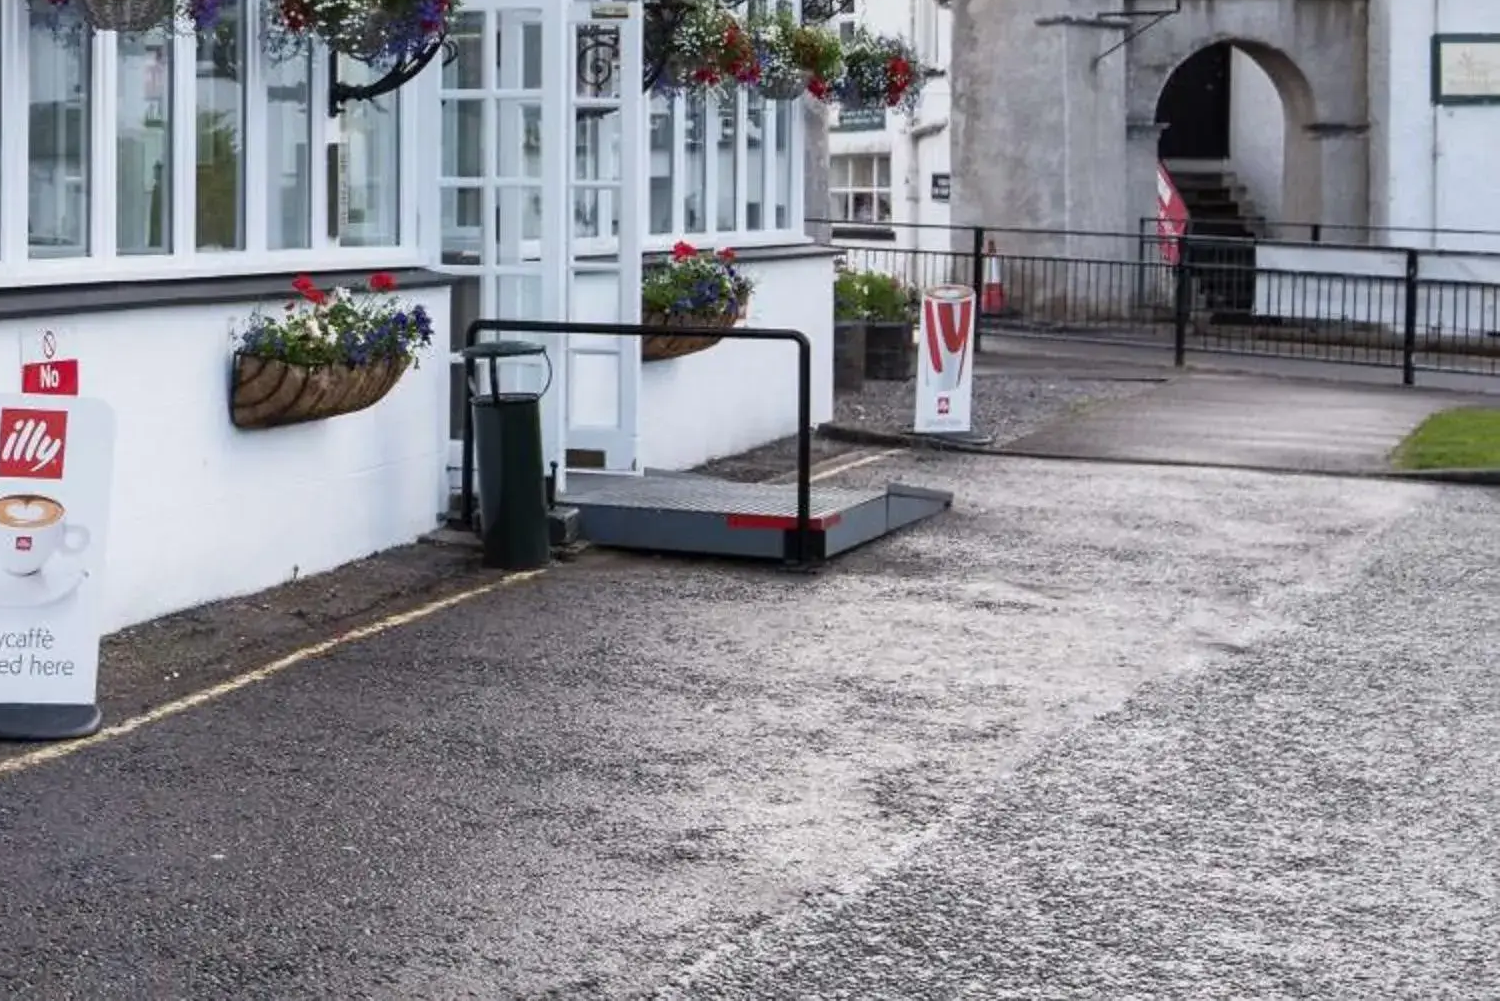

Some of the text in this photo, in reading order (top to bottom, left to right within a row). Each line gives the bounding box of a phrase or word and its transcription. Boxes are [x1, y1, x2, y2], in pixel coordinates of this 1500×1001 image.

[39, 365, 60, 388] No
[2, 418, 63, 472] illy
[29, 654, 75, 676] here
